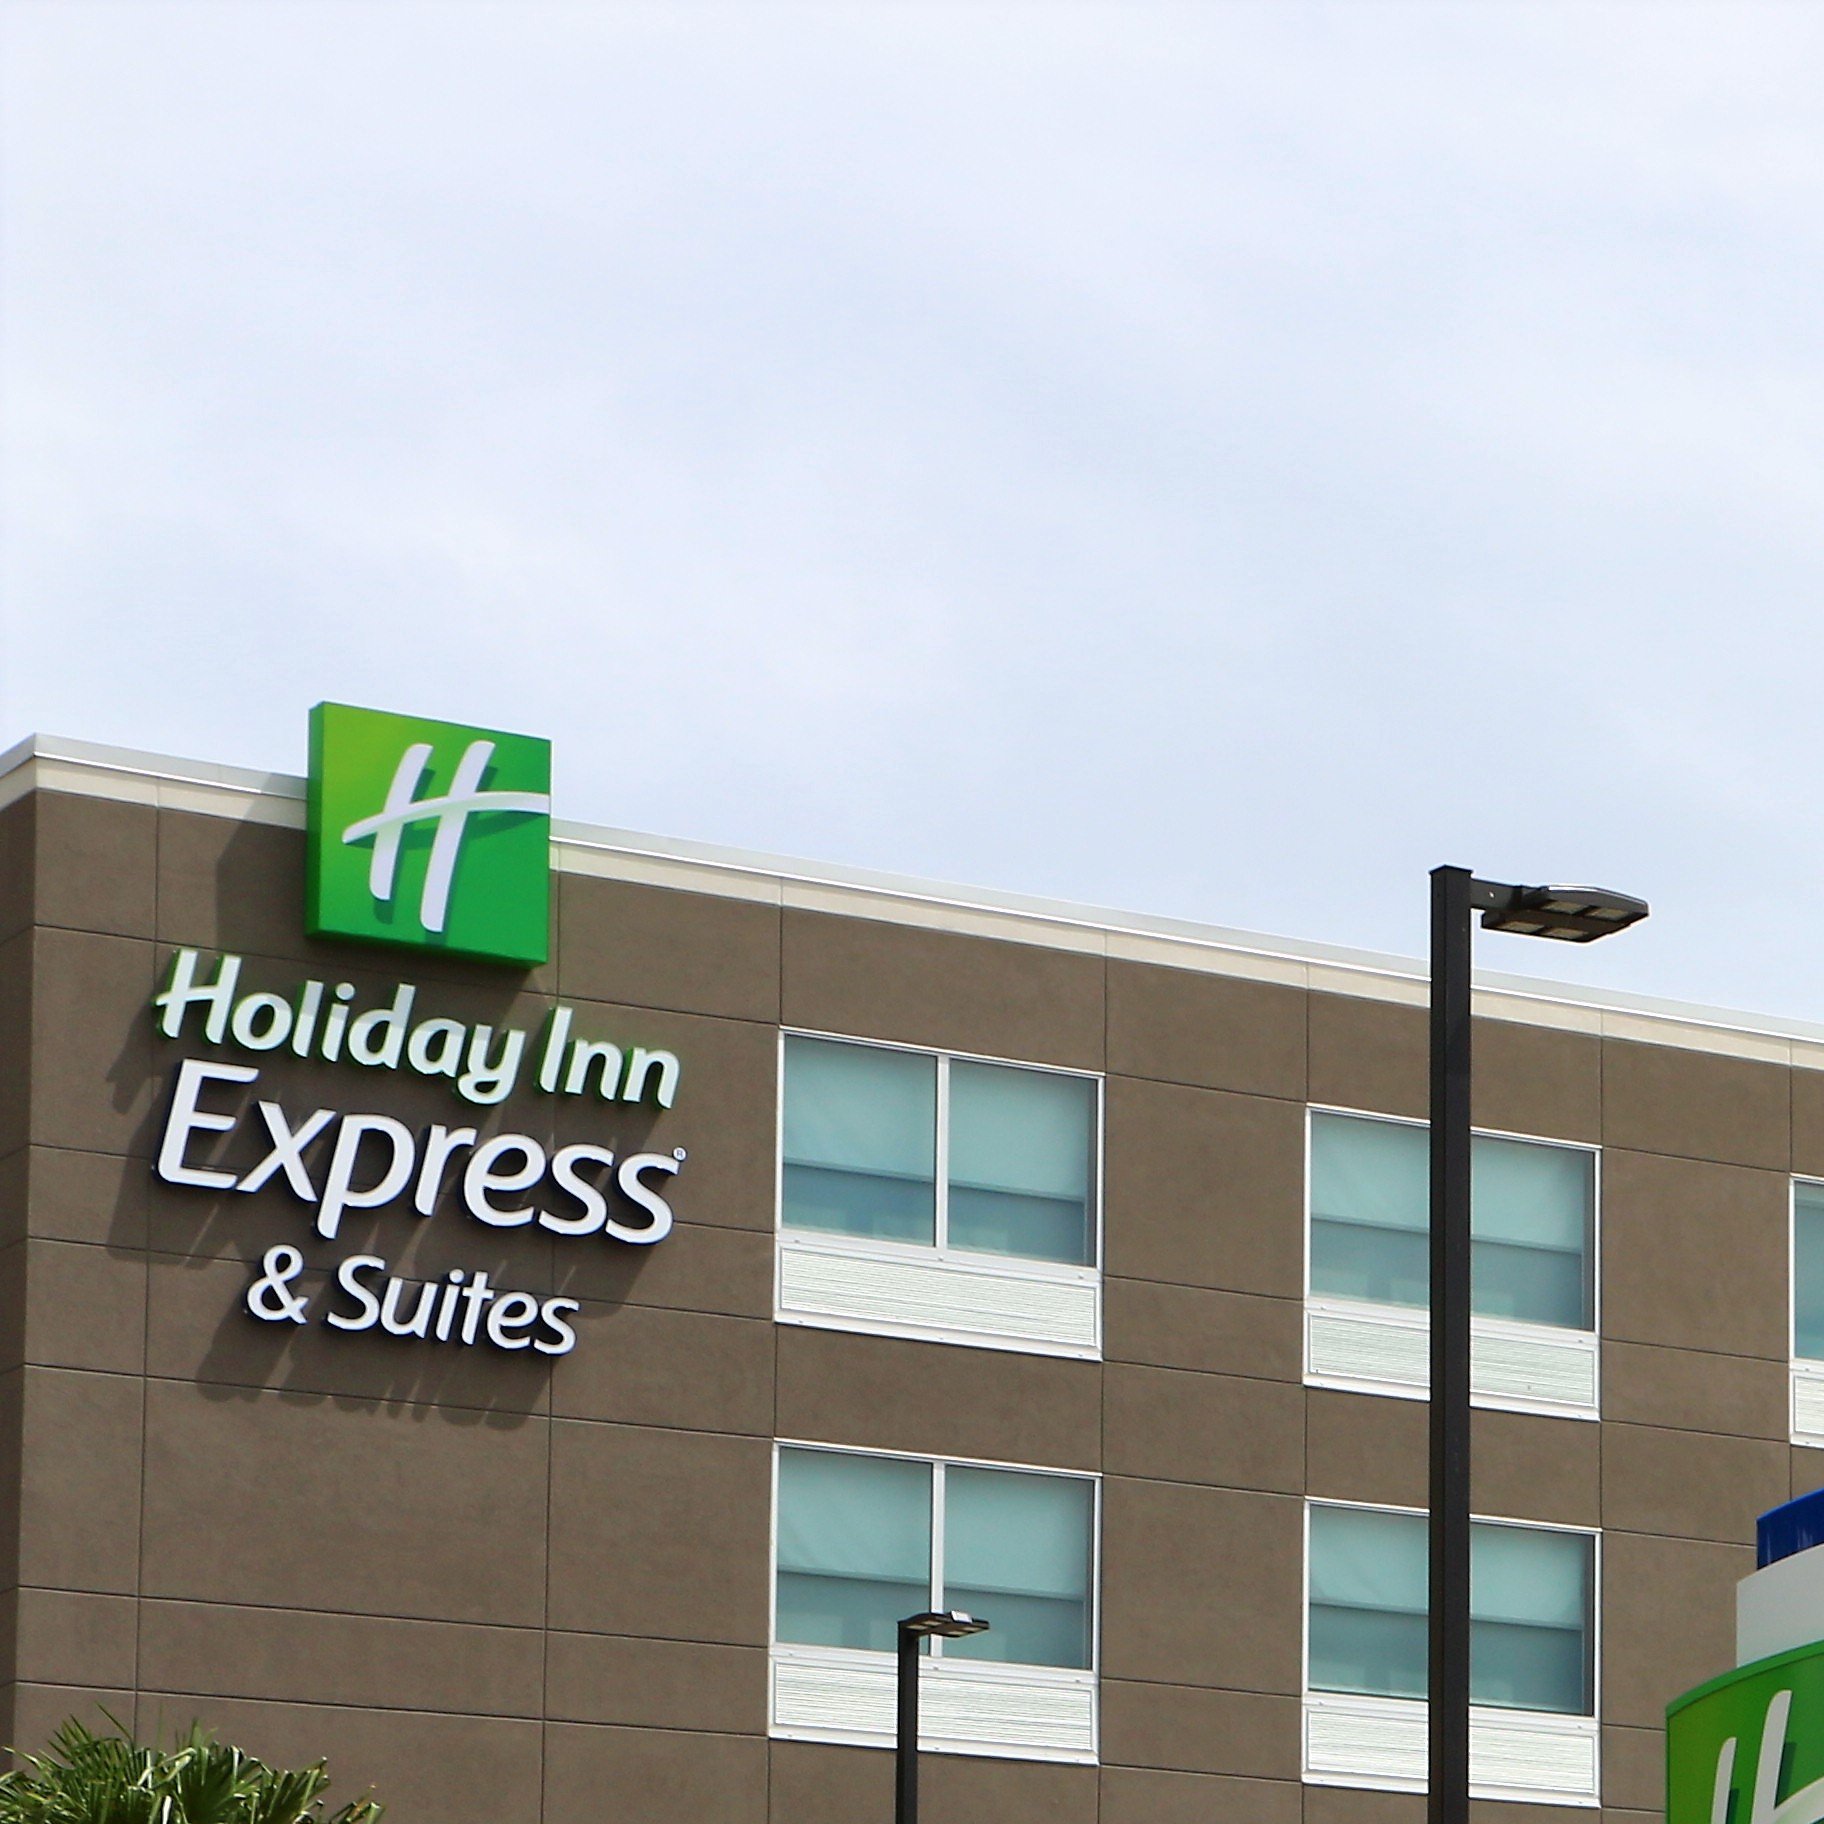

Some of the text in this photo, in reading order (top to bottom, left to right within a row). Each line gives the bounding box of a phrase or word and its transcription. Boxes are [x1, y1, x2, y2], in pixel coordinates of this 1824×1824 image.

[154, 947, 681, 1111] Holiday Inn
[154, 1059, 682, 1247] Express
[245, 1243, 581, 1357] & Suites
